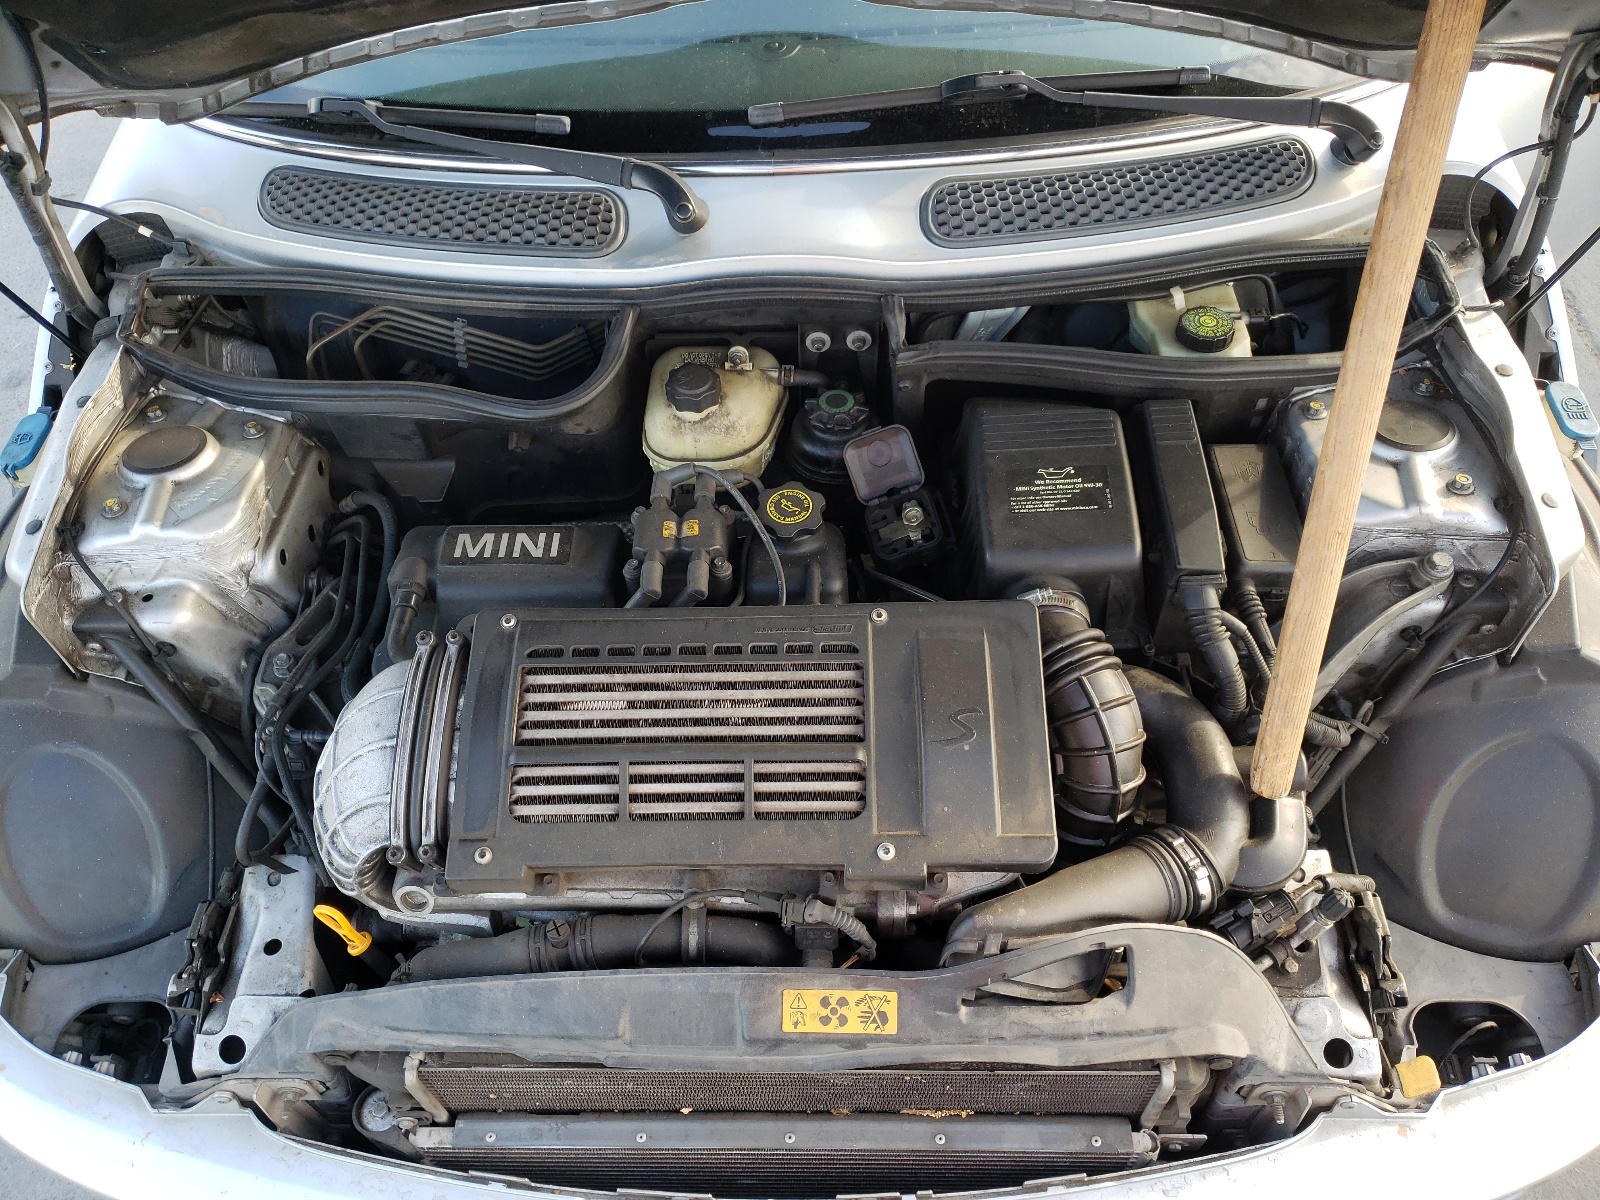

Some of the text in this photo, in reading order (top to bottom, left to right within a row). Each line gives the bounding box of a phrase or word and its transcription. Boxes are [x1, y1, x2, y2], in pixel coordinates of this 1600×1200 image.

[784, 510, 808, 522] MANUAL
[453, 532, 561, 558] MINI
[928, 706, 984, 750] S
